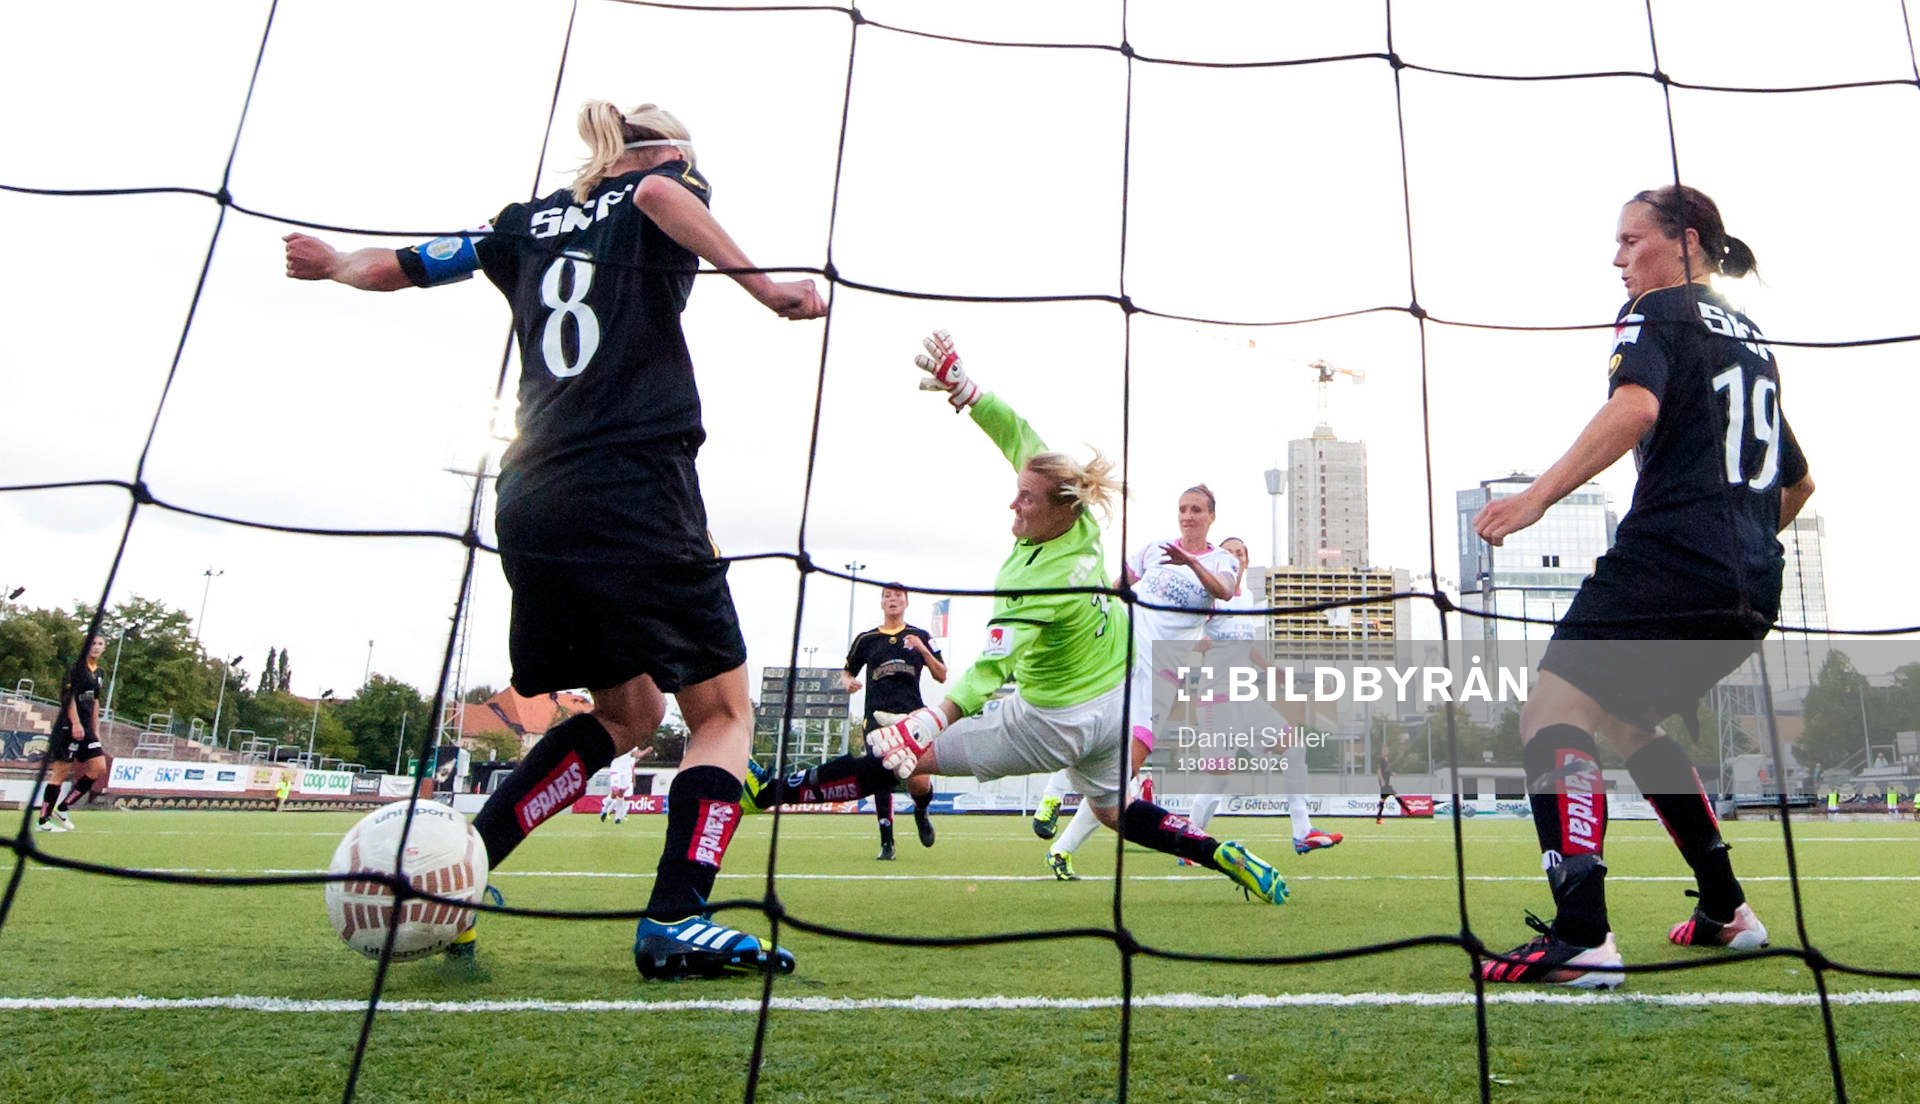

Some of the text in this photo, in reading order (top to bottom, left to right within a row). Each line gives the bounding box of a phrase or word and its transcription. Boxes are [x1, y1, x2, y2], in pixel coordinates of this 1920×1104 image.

[540, 250, 600, 378] 8
[1712, 366, 1781, 491] 19
[114, 765, 143, 781] SKF
[154, 767, 182, 783] SKF
[522, 762, 582, 828] Stavdal
[1563, 753, 1600, 850] Stavdal
[374, 807, 454, 825] uhlport
[696, 802, 734, 867] Stavdal
